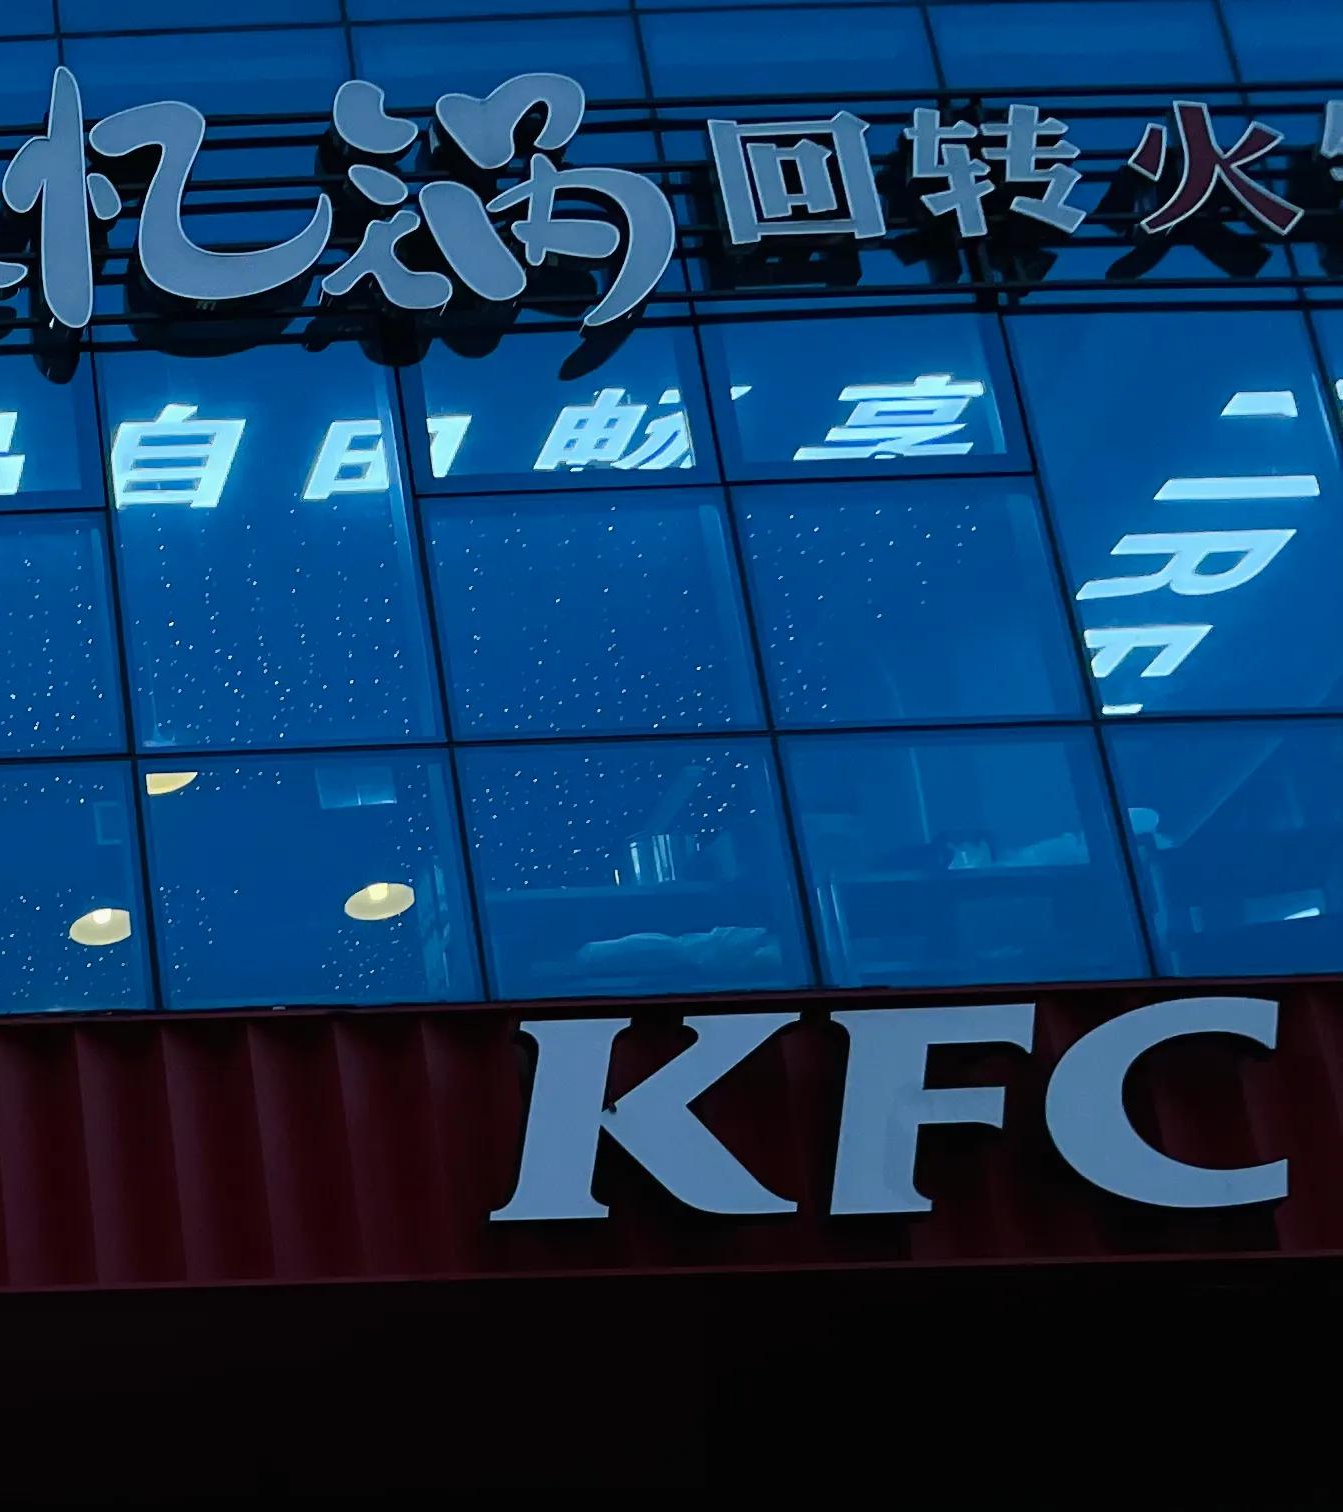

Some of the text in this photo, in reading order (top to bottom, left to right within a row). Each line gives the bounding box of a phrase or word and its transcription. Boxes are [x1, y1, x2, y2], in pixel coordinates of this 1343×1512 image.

[706, 101, 1343, 245] 回转火
[489, 995, 1290, 1224] KFC
